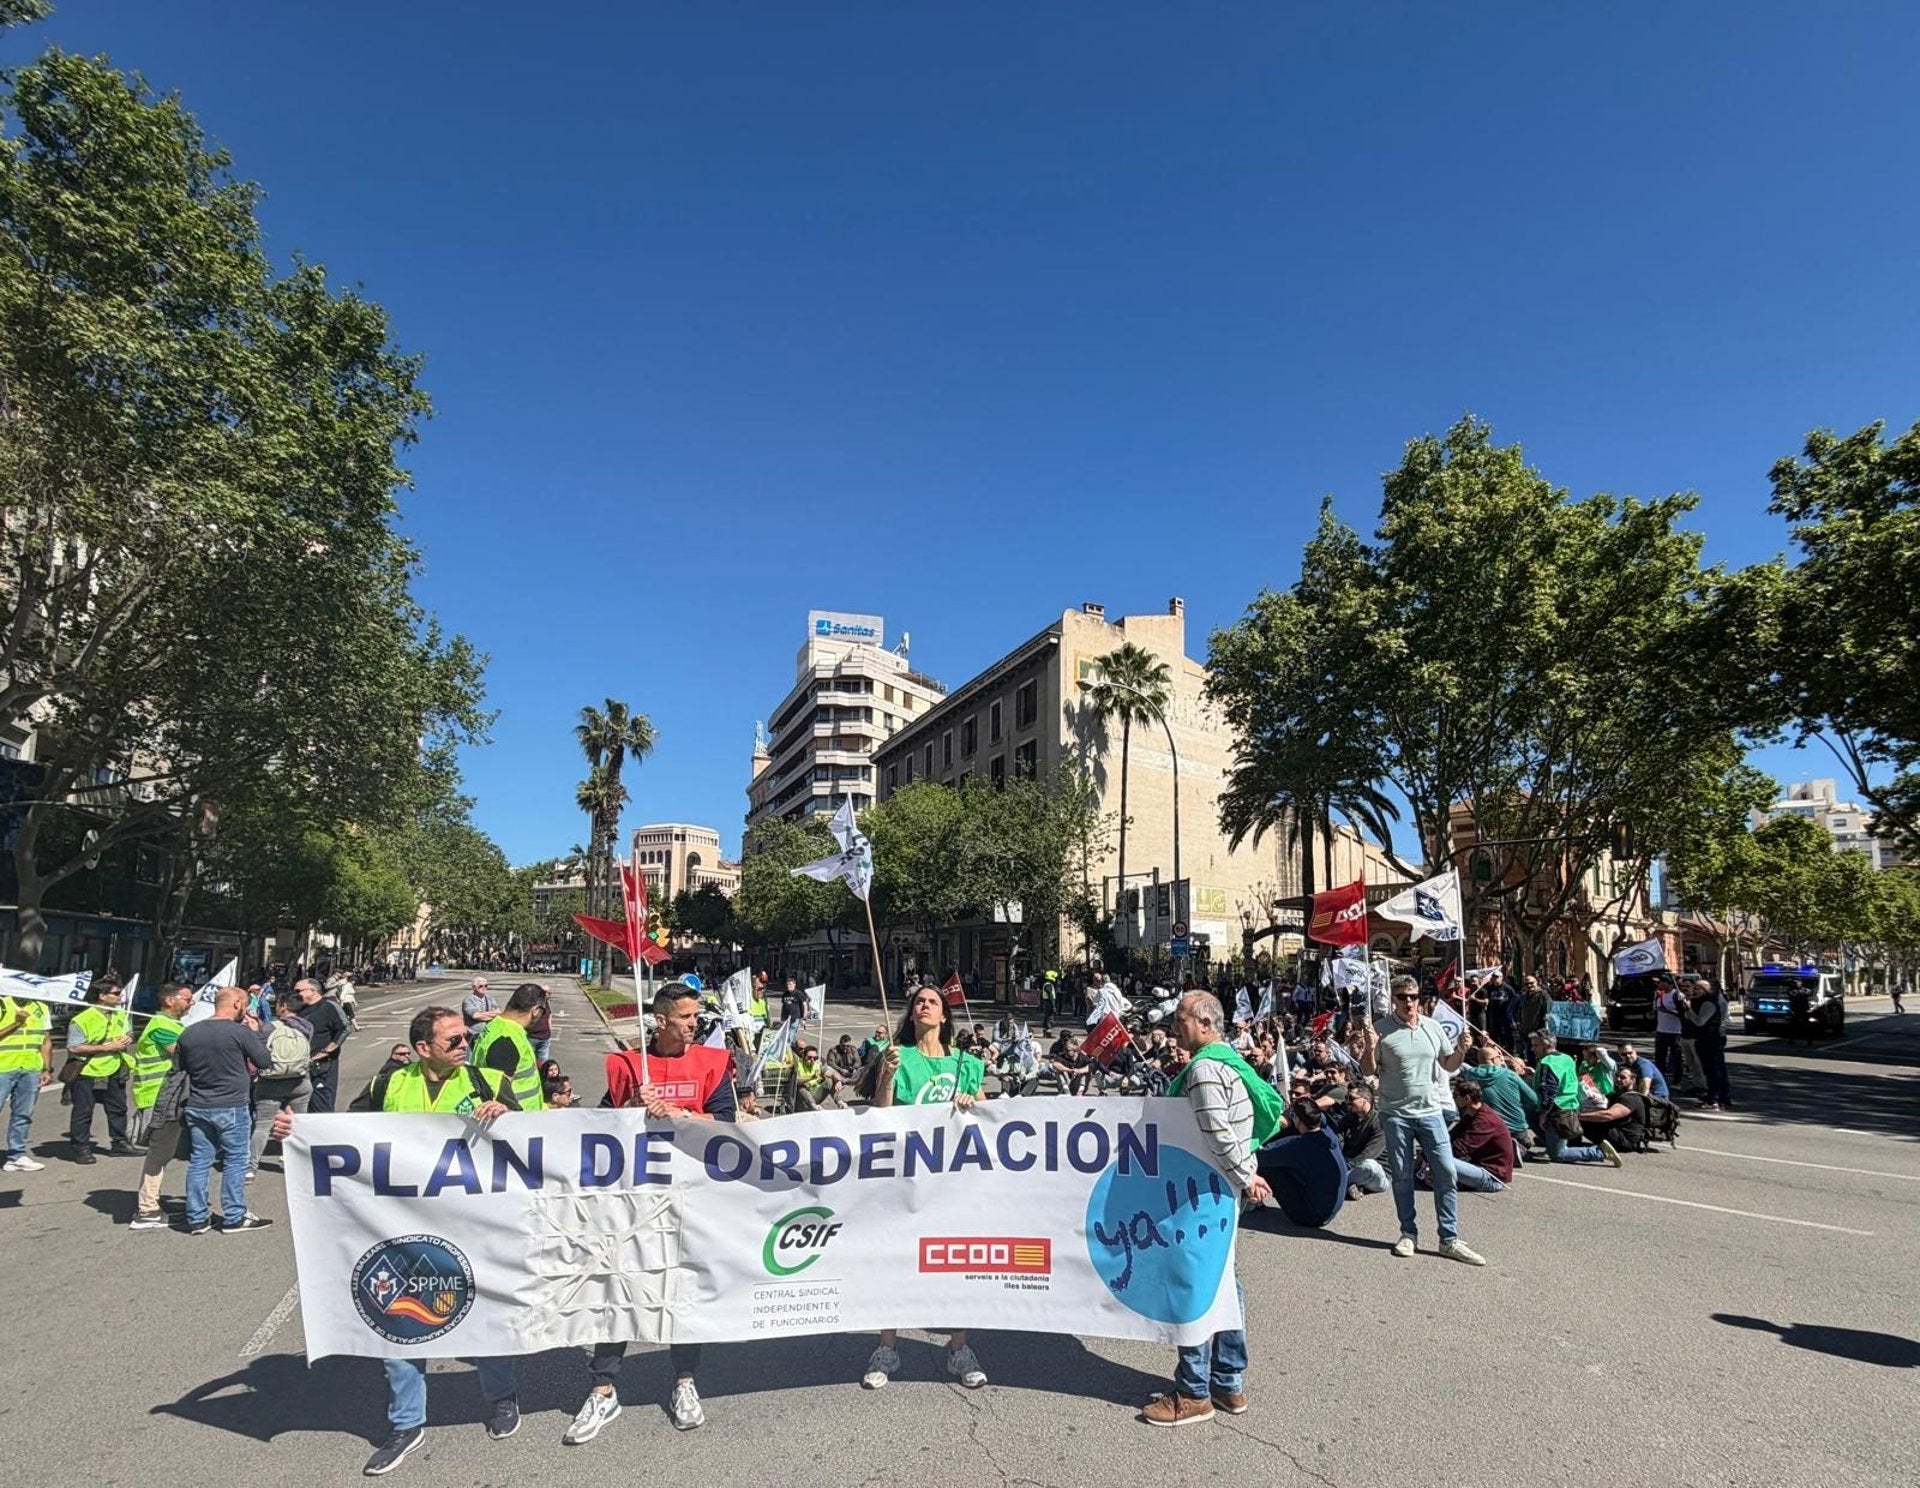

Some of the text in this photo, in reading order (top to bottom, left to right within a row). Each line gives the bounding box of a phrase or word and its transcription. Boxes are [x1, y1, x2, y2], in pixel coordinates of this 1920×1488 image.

[833, 623, 875, 637] Sanitas
[310, 1109, 1159, 1197] PLAN DE ORDENACIÓN
[778, 1222, 843, 1249] CSIF
[925, 1244, 1010, 1265] CCOO
[408, 1276, 463, 1292] SPPME
[1021, 1282, 1050, 1291] balears
[754, 1287, 840, 1300] CENTRAL SINDICAL
[753, 1301, 840, 1314] INDEPENDIENTE Y
[752, 1314, 840, 1329] DE FUNCIONARIOS
